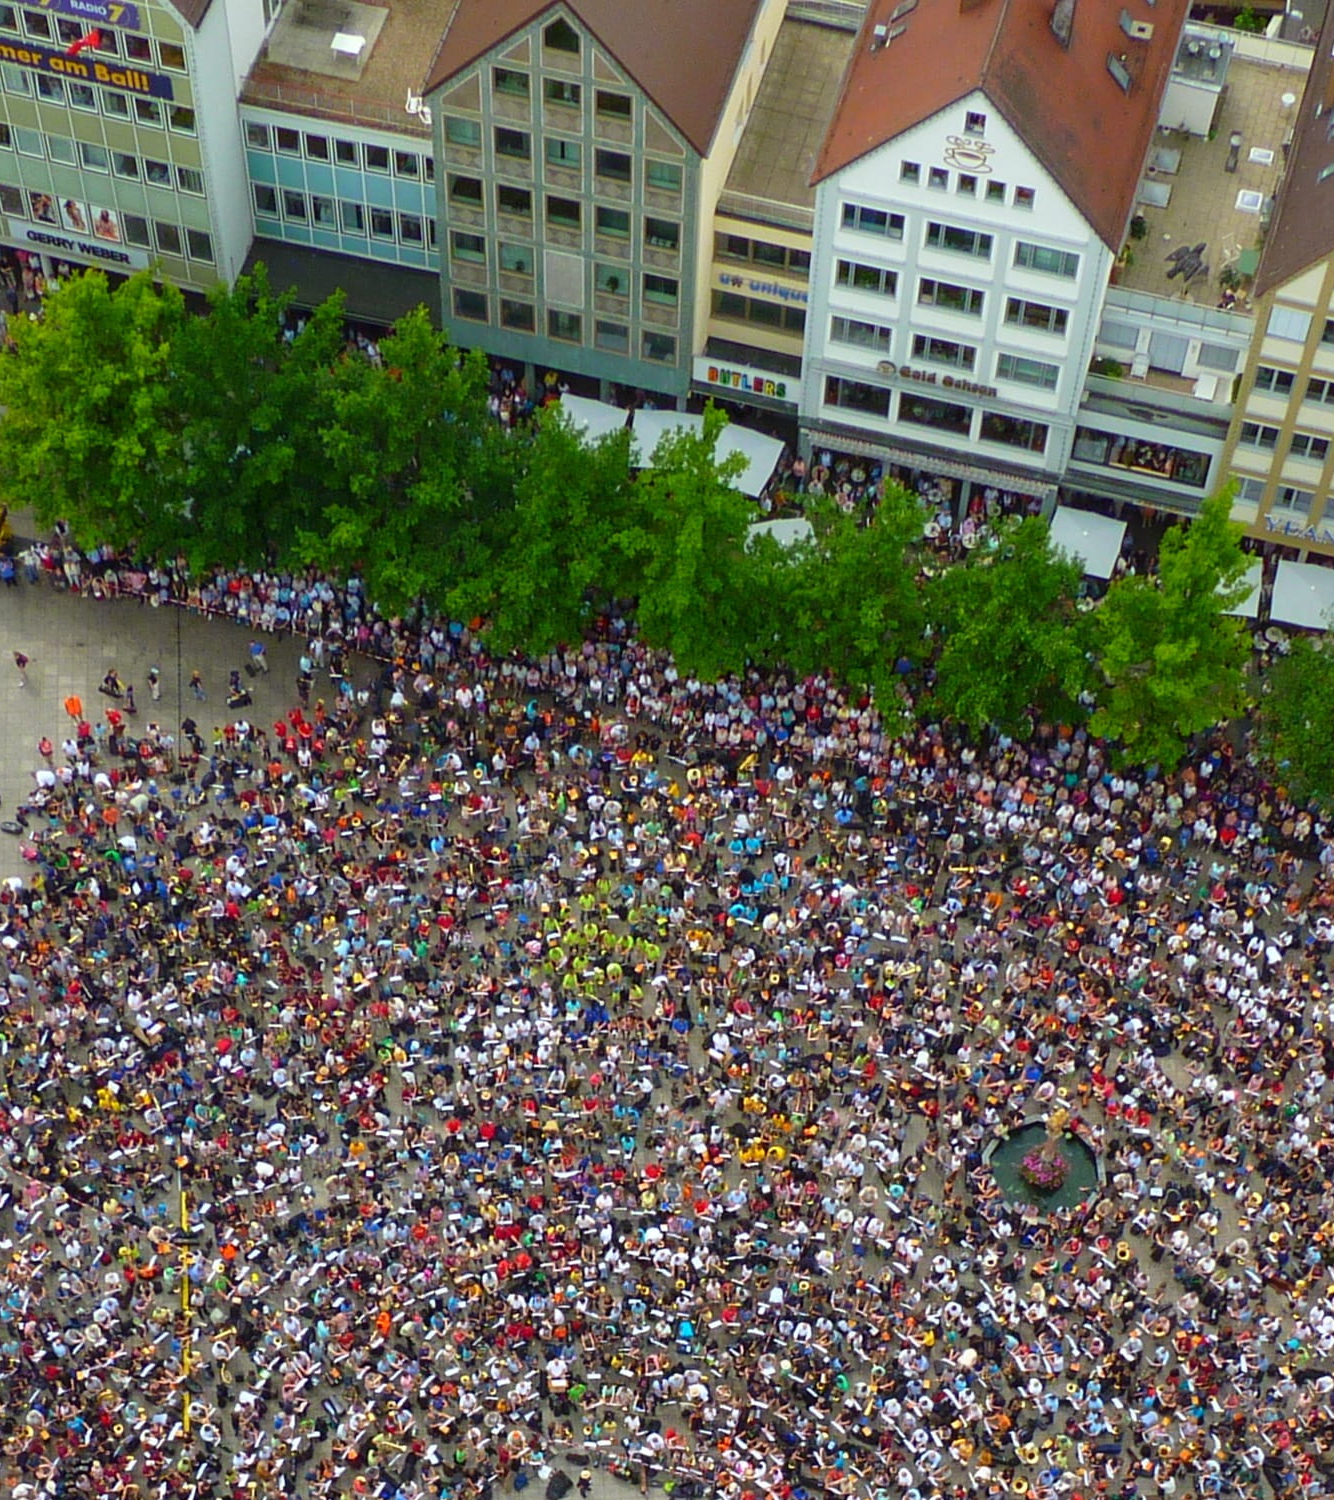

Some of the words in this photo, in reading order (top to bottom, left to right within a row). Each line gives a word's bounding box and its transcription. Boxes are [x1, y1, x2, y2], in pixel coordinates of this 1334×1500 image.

[70, 0, 107, 15] RADIO
[108, 4, 125, 22] 7
[49, 55, 88, 77] am
[94, 63, 150, 91] Ball!
[27, 230, 75, 250] GERRY
[77, 242, 131, 264] WEBER
[708, 366, 786, 398] BUTLERS
